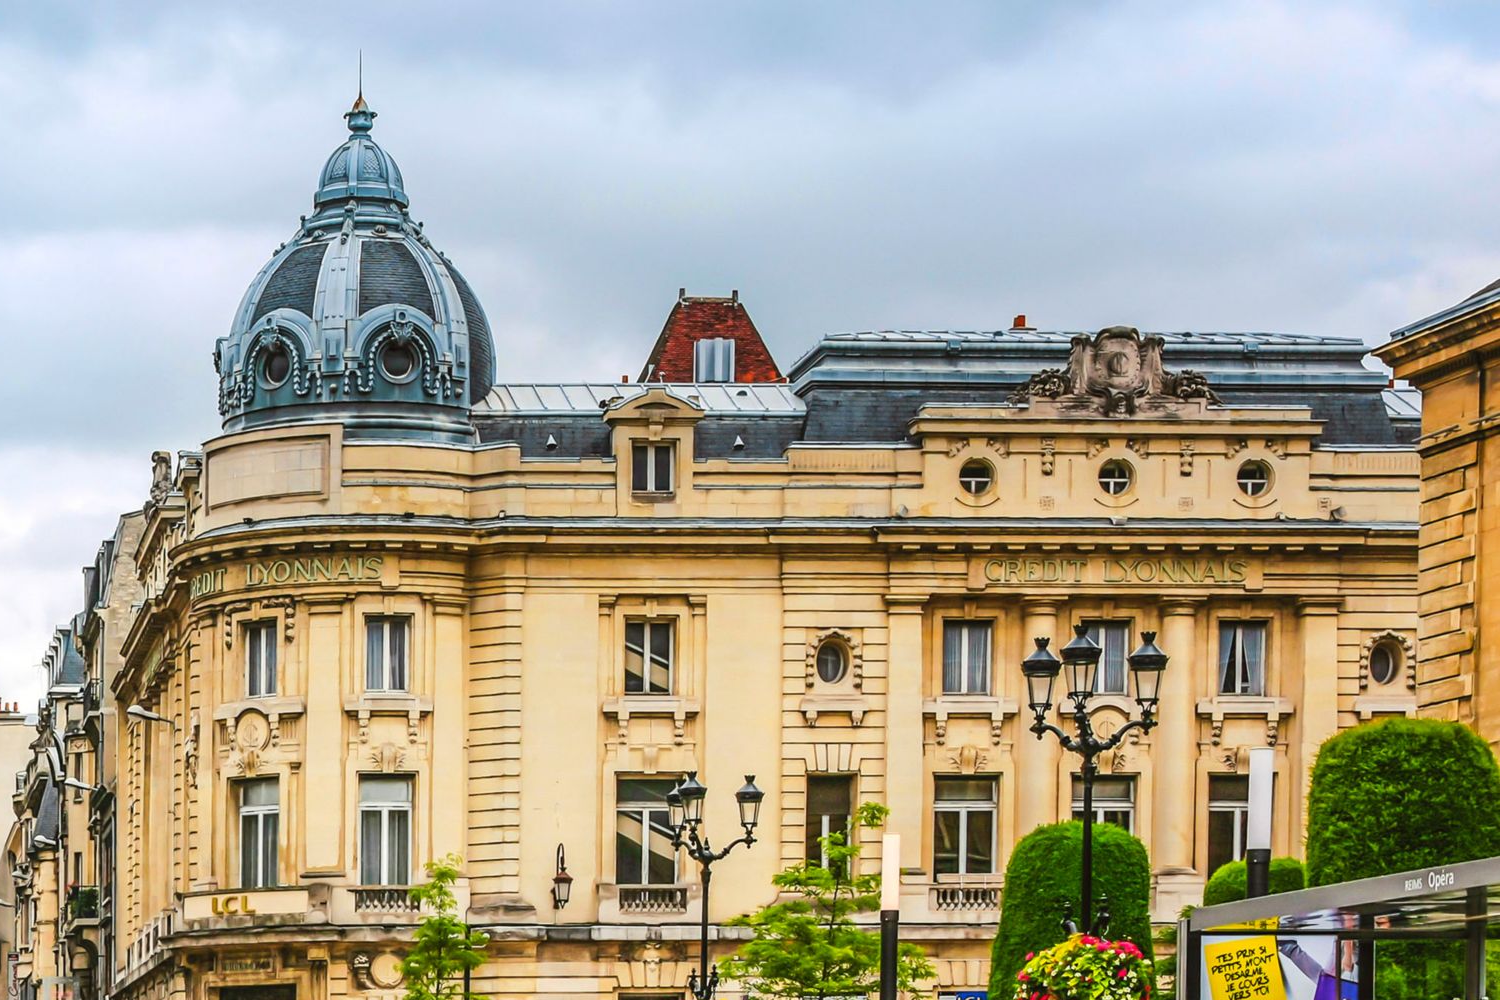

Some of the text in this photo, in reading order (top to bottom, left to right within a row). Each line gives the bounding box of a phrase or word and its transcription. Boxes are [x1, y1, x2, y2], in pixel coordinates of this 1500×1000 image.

[190, 557, 382, 600] REDIT LYONNAIS
[985, 559, 1247, 583] CREDIT LYONNAIS
[1404, 869, 1454, 892] REIMS Opéra
[211, 895, 256, 915] LCL
[1216, 945, 1267, 963] TES PRIX SI
[1211, 961, 1242, 975] PETITS
[1225, 975, 1270, 993] JE COURS
[1253, 985, 1270, 996] TOI
